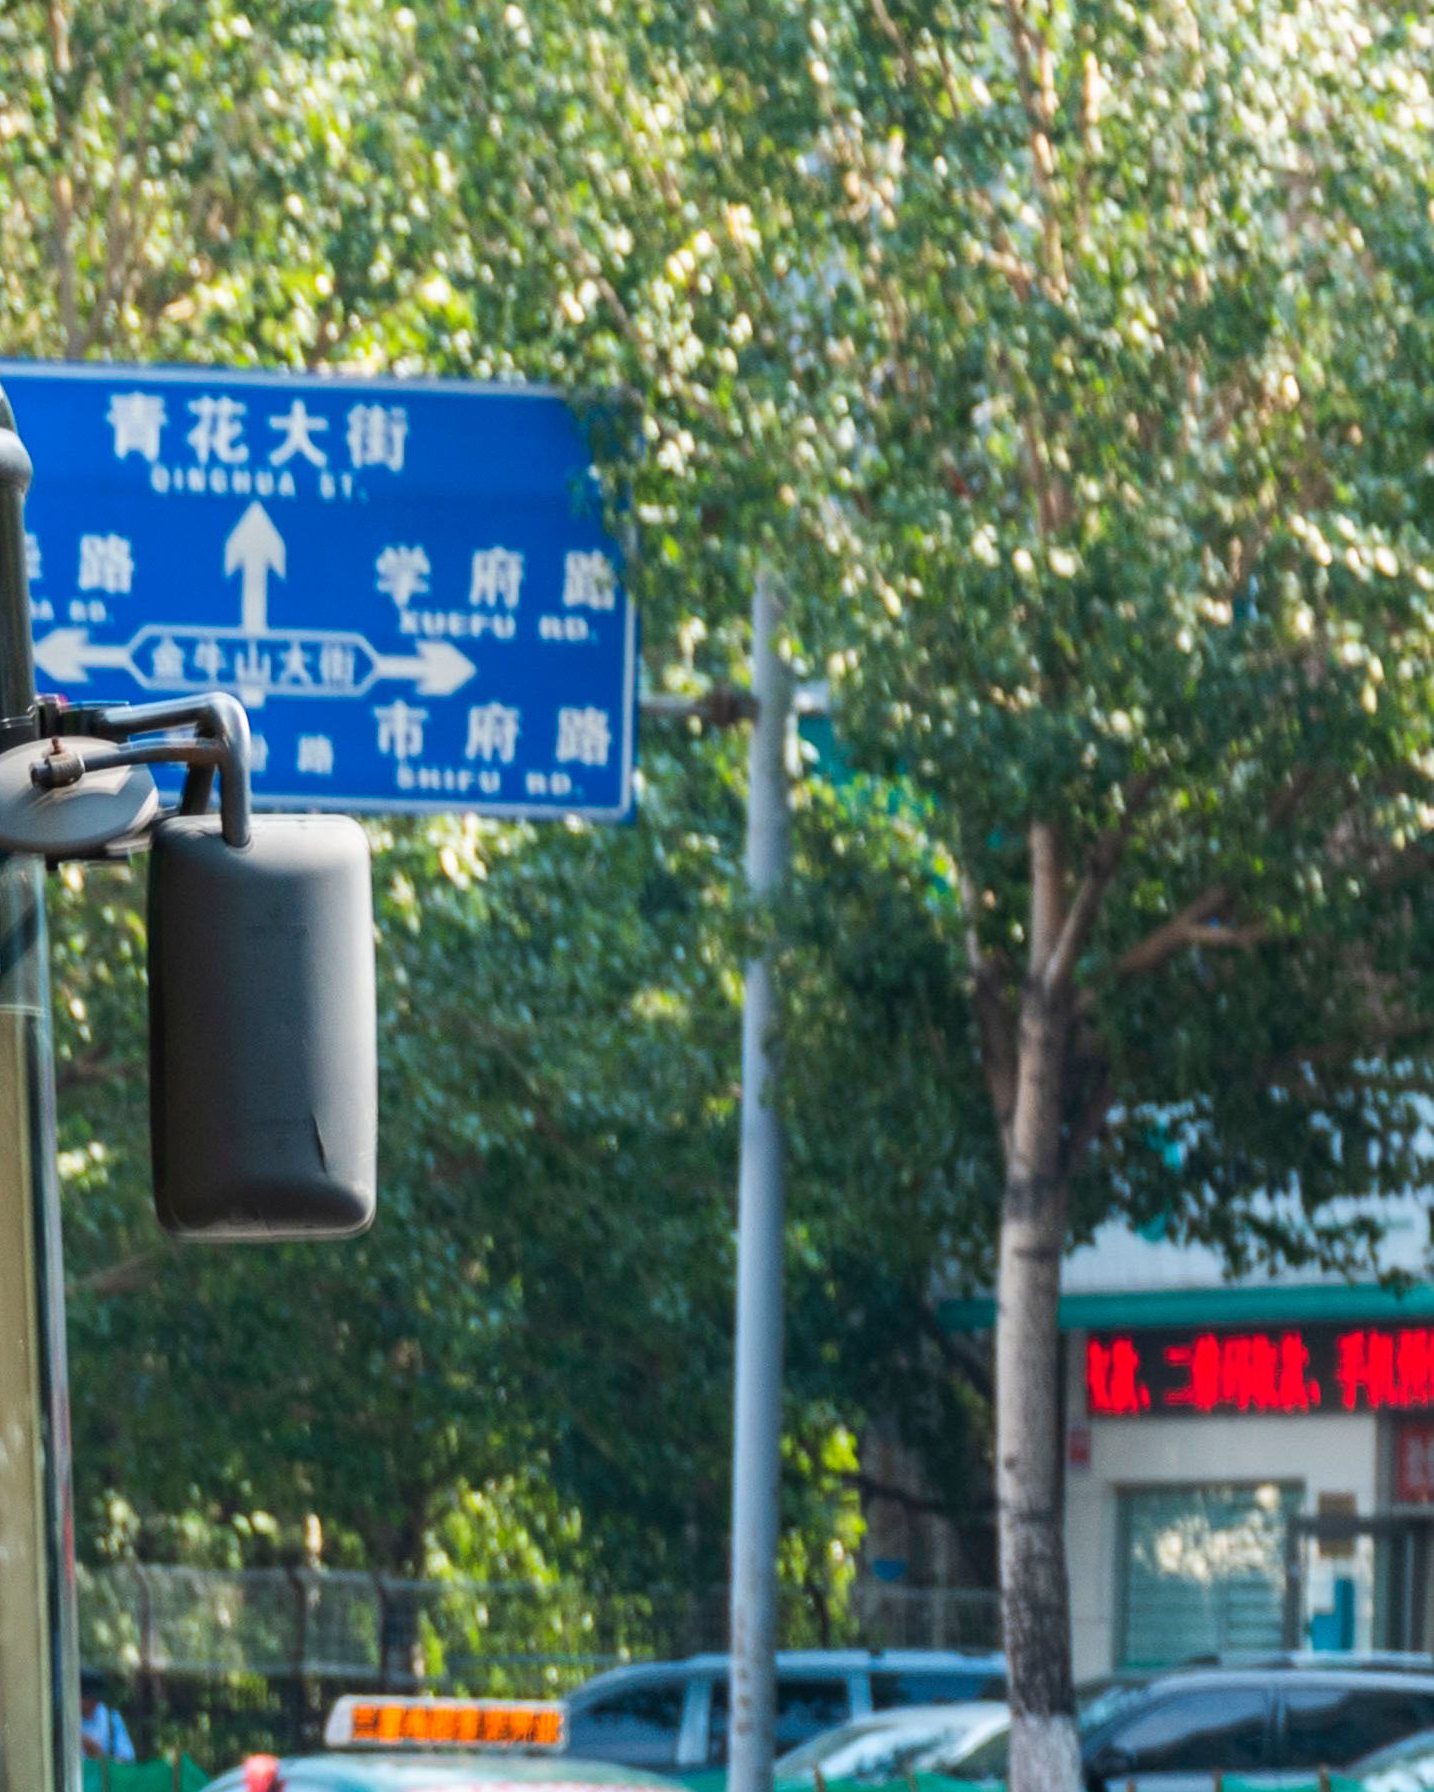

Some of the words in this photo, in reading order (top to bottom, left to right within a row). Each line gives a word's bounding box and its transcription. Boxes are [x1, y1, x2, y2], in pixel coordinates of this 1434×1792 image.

[106, 392, 409, 473] 青花大街
[375, 543, 617, 611] 学府路
[150, 637, 356, 687] 金牛山大街
[374, 699, 612, 767] 市府路
